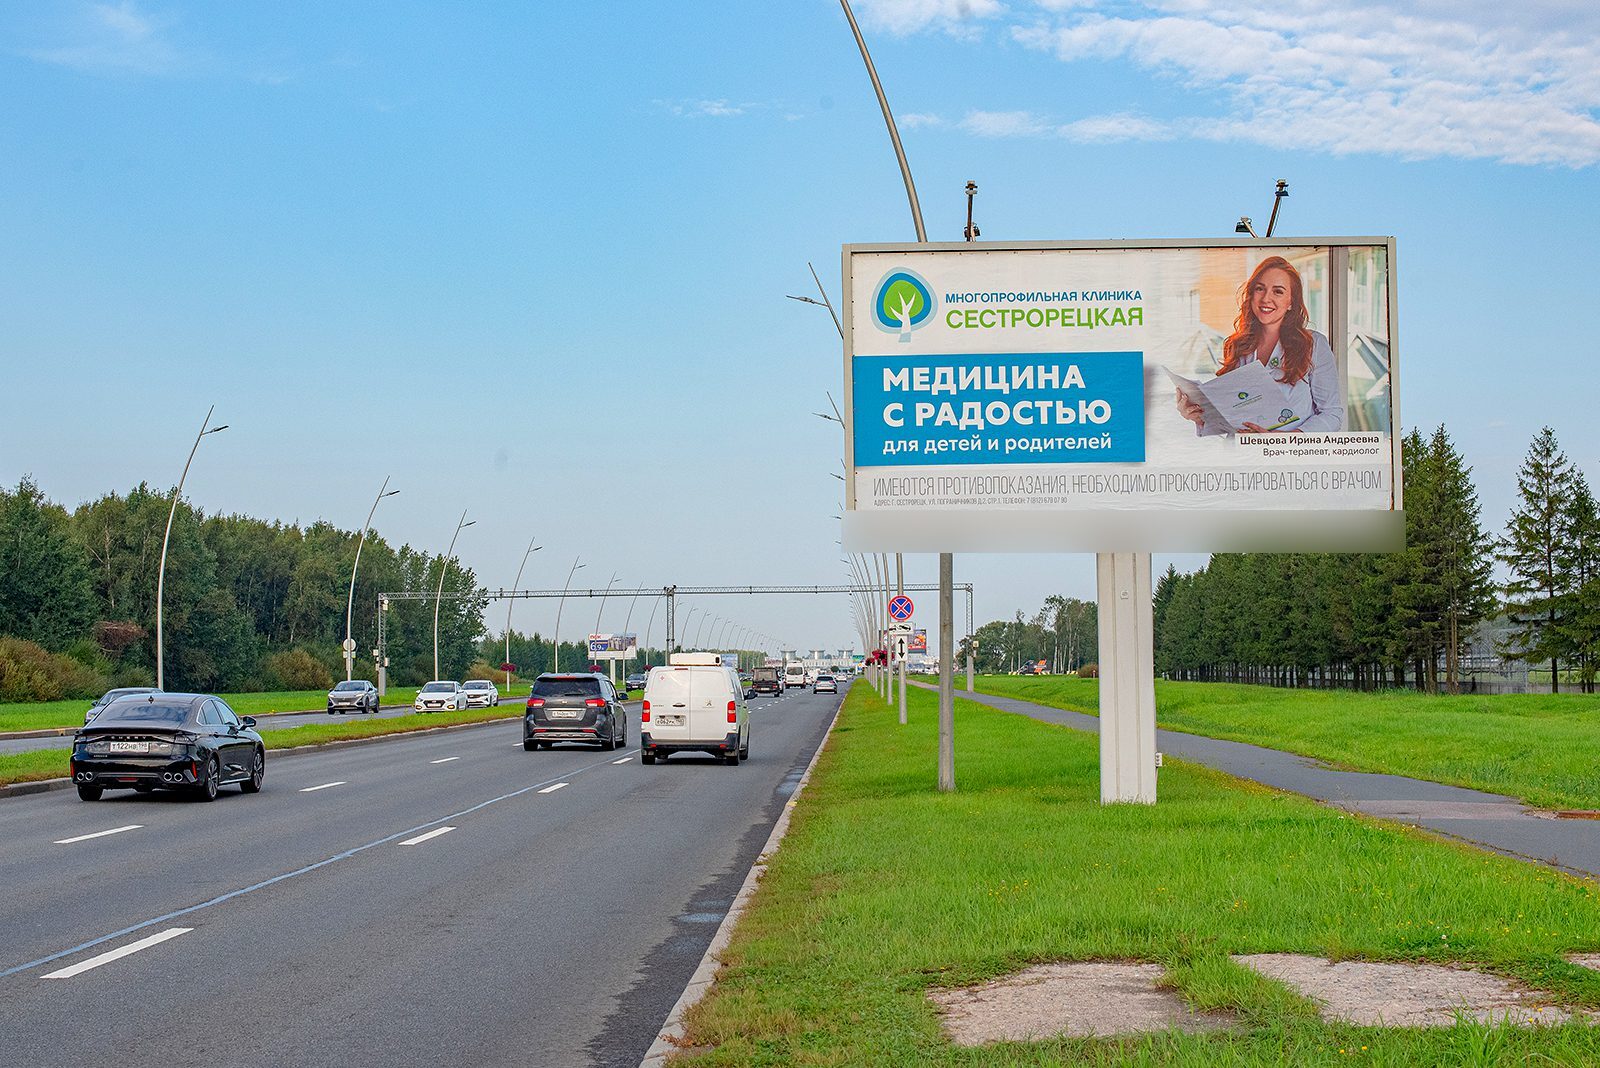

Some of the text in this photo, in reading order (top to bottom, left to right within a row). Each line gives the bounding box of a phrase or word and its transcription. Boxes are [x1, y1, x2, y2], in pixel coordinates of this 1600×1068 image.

[945, 290, 1142, 304] МНОГОПРОФИЛЬНАЯ КЛИНИКА
[945, 307, 1143, 330] СЕСТРОРЕЦКАЯ
[883, 365, 1086, 395] МЕДИЦИНА
[882, 399, 1112, 430] С РАДОСТЬЮ
[882, 432, 1112, 454] для детей и родителей
[1239, 434, 1380, 447] Шевцова Ирина Андреевна
[1263, 446, 1380, 457] Врач-терапевт, кардиолог
[873, 470, 1382, 497] ИМЕЮТСЯ ПРОТИВОПОКАЗАНИЯ, НЕОБХОДИМО ПРОКОНСУЛЬТИРОВАТЬСЯ С ВРАЧОМ
